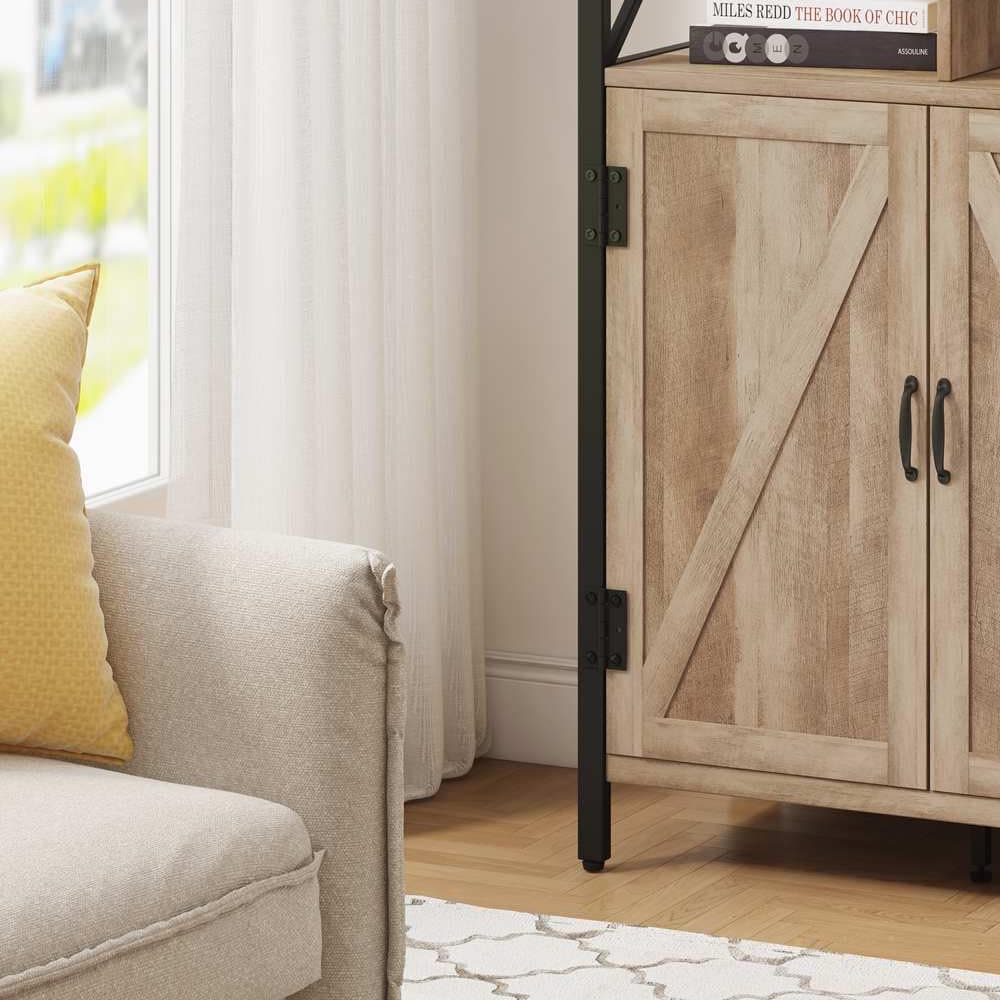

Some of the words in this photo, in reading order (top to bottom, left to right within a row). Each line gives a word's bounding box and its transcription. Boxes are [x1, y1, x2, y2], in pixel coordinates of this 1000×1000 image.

[712, 2, 753, 18] MILES
[756, 4, 792, 20] REDD
[795, 6, 822, 22] THE
[825, 8, 862, 24] BOOK
[865, 10, 883, 24] OF
[886, 10, 918, 26] CHIC
[897, 48, 929, 56] ASSOULINE
